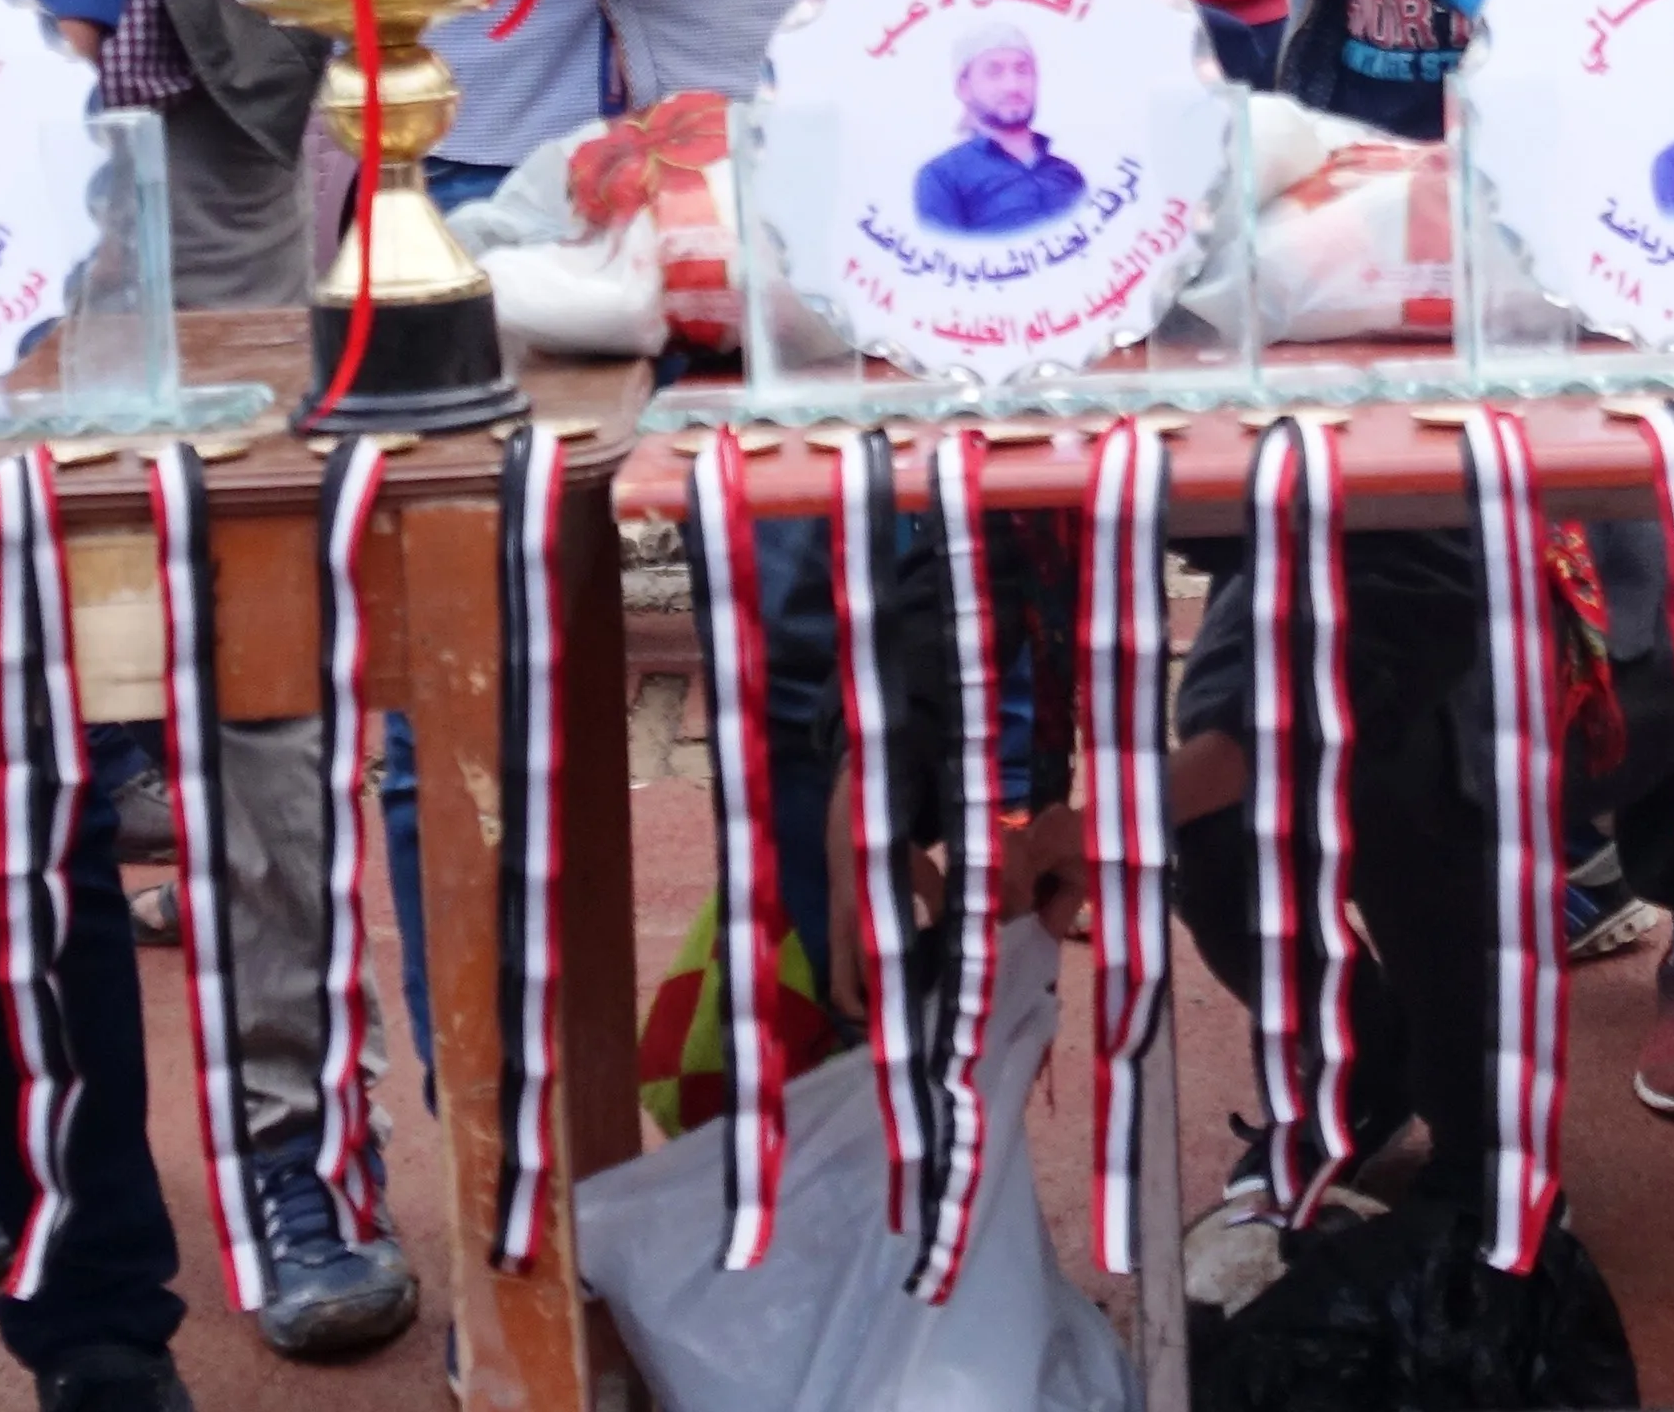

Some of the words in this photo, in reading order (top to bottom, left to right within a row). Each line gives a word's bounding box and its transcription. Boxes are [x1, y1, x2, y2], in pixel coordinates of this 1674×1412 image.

[857, 204, 959, 287] والرياضة
[1037, 223, 1089, 266] لجنة
[1137, 196, 1187, 253] دورة
[963, 248, 1038, 291] الشباب
[1085, 248, 1151, 321] الشهيد
[1025, 309, 1081, 354] سالم
